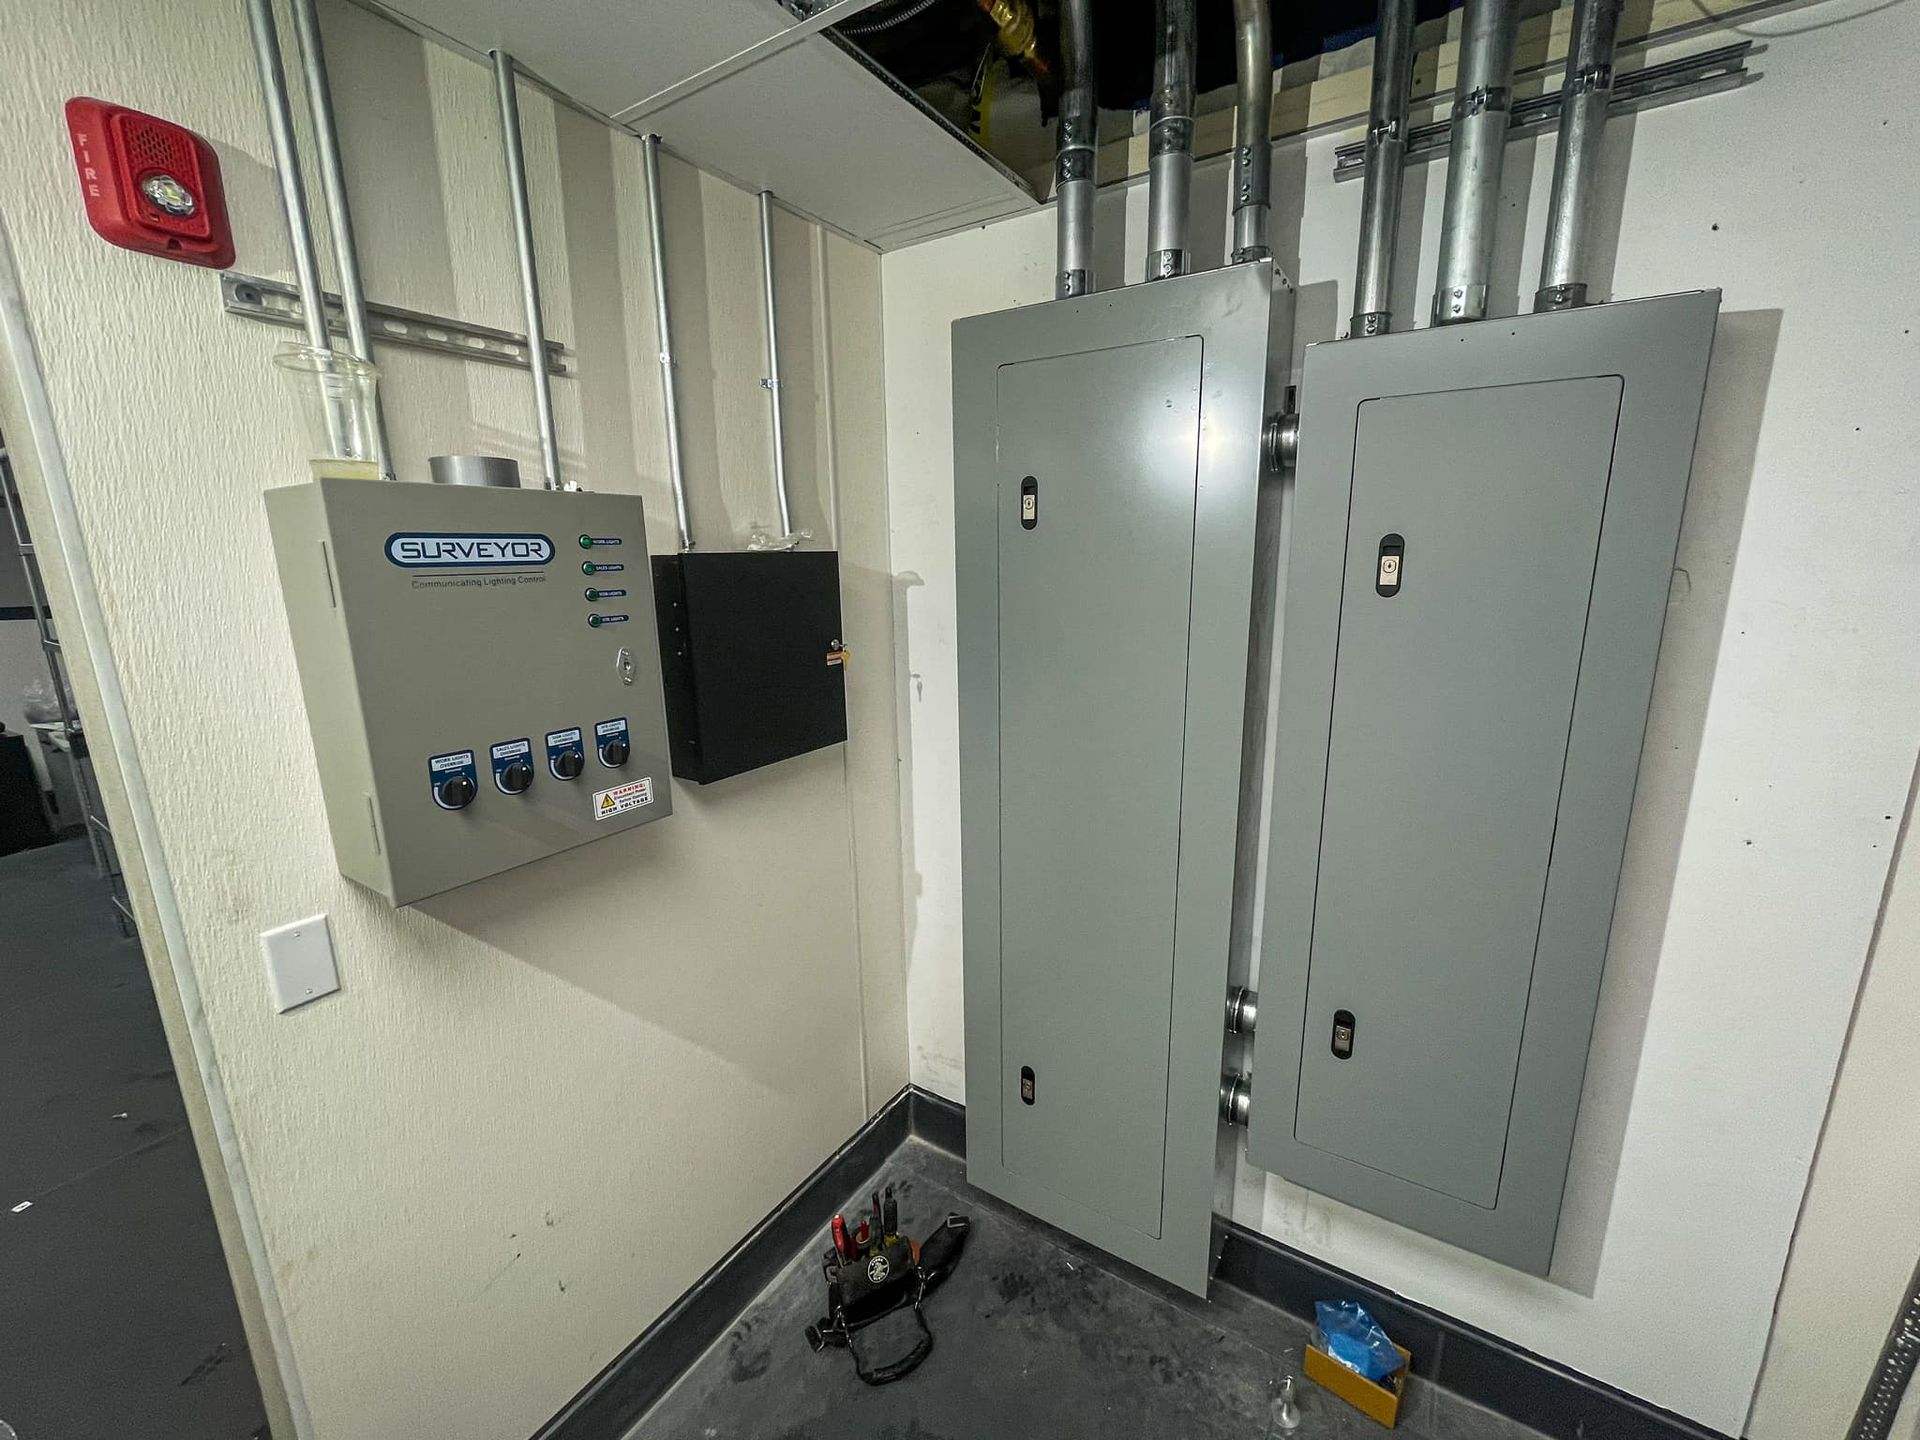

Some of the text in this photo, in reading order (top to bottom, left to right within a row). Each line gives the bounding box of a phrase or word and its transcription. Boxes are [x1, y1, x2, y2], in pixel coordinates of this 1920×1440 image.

[77, 133, 100, 197] FIRE
[400, 541, 544, 560] SURVEYOR
[411, 575, 546, 589] Communicating Lighting Control
[434, 756, 451, 765] WORK
[439, 760, 464, 769] OVERRIDE
[601, 796, 648, 815] HIGH VOLTAGE
